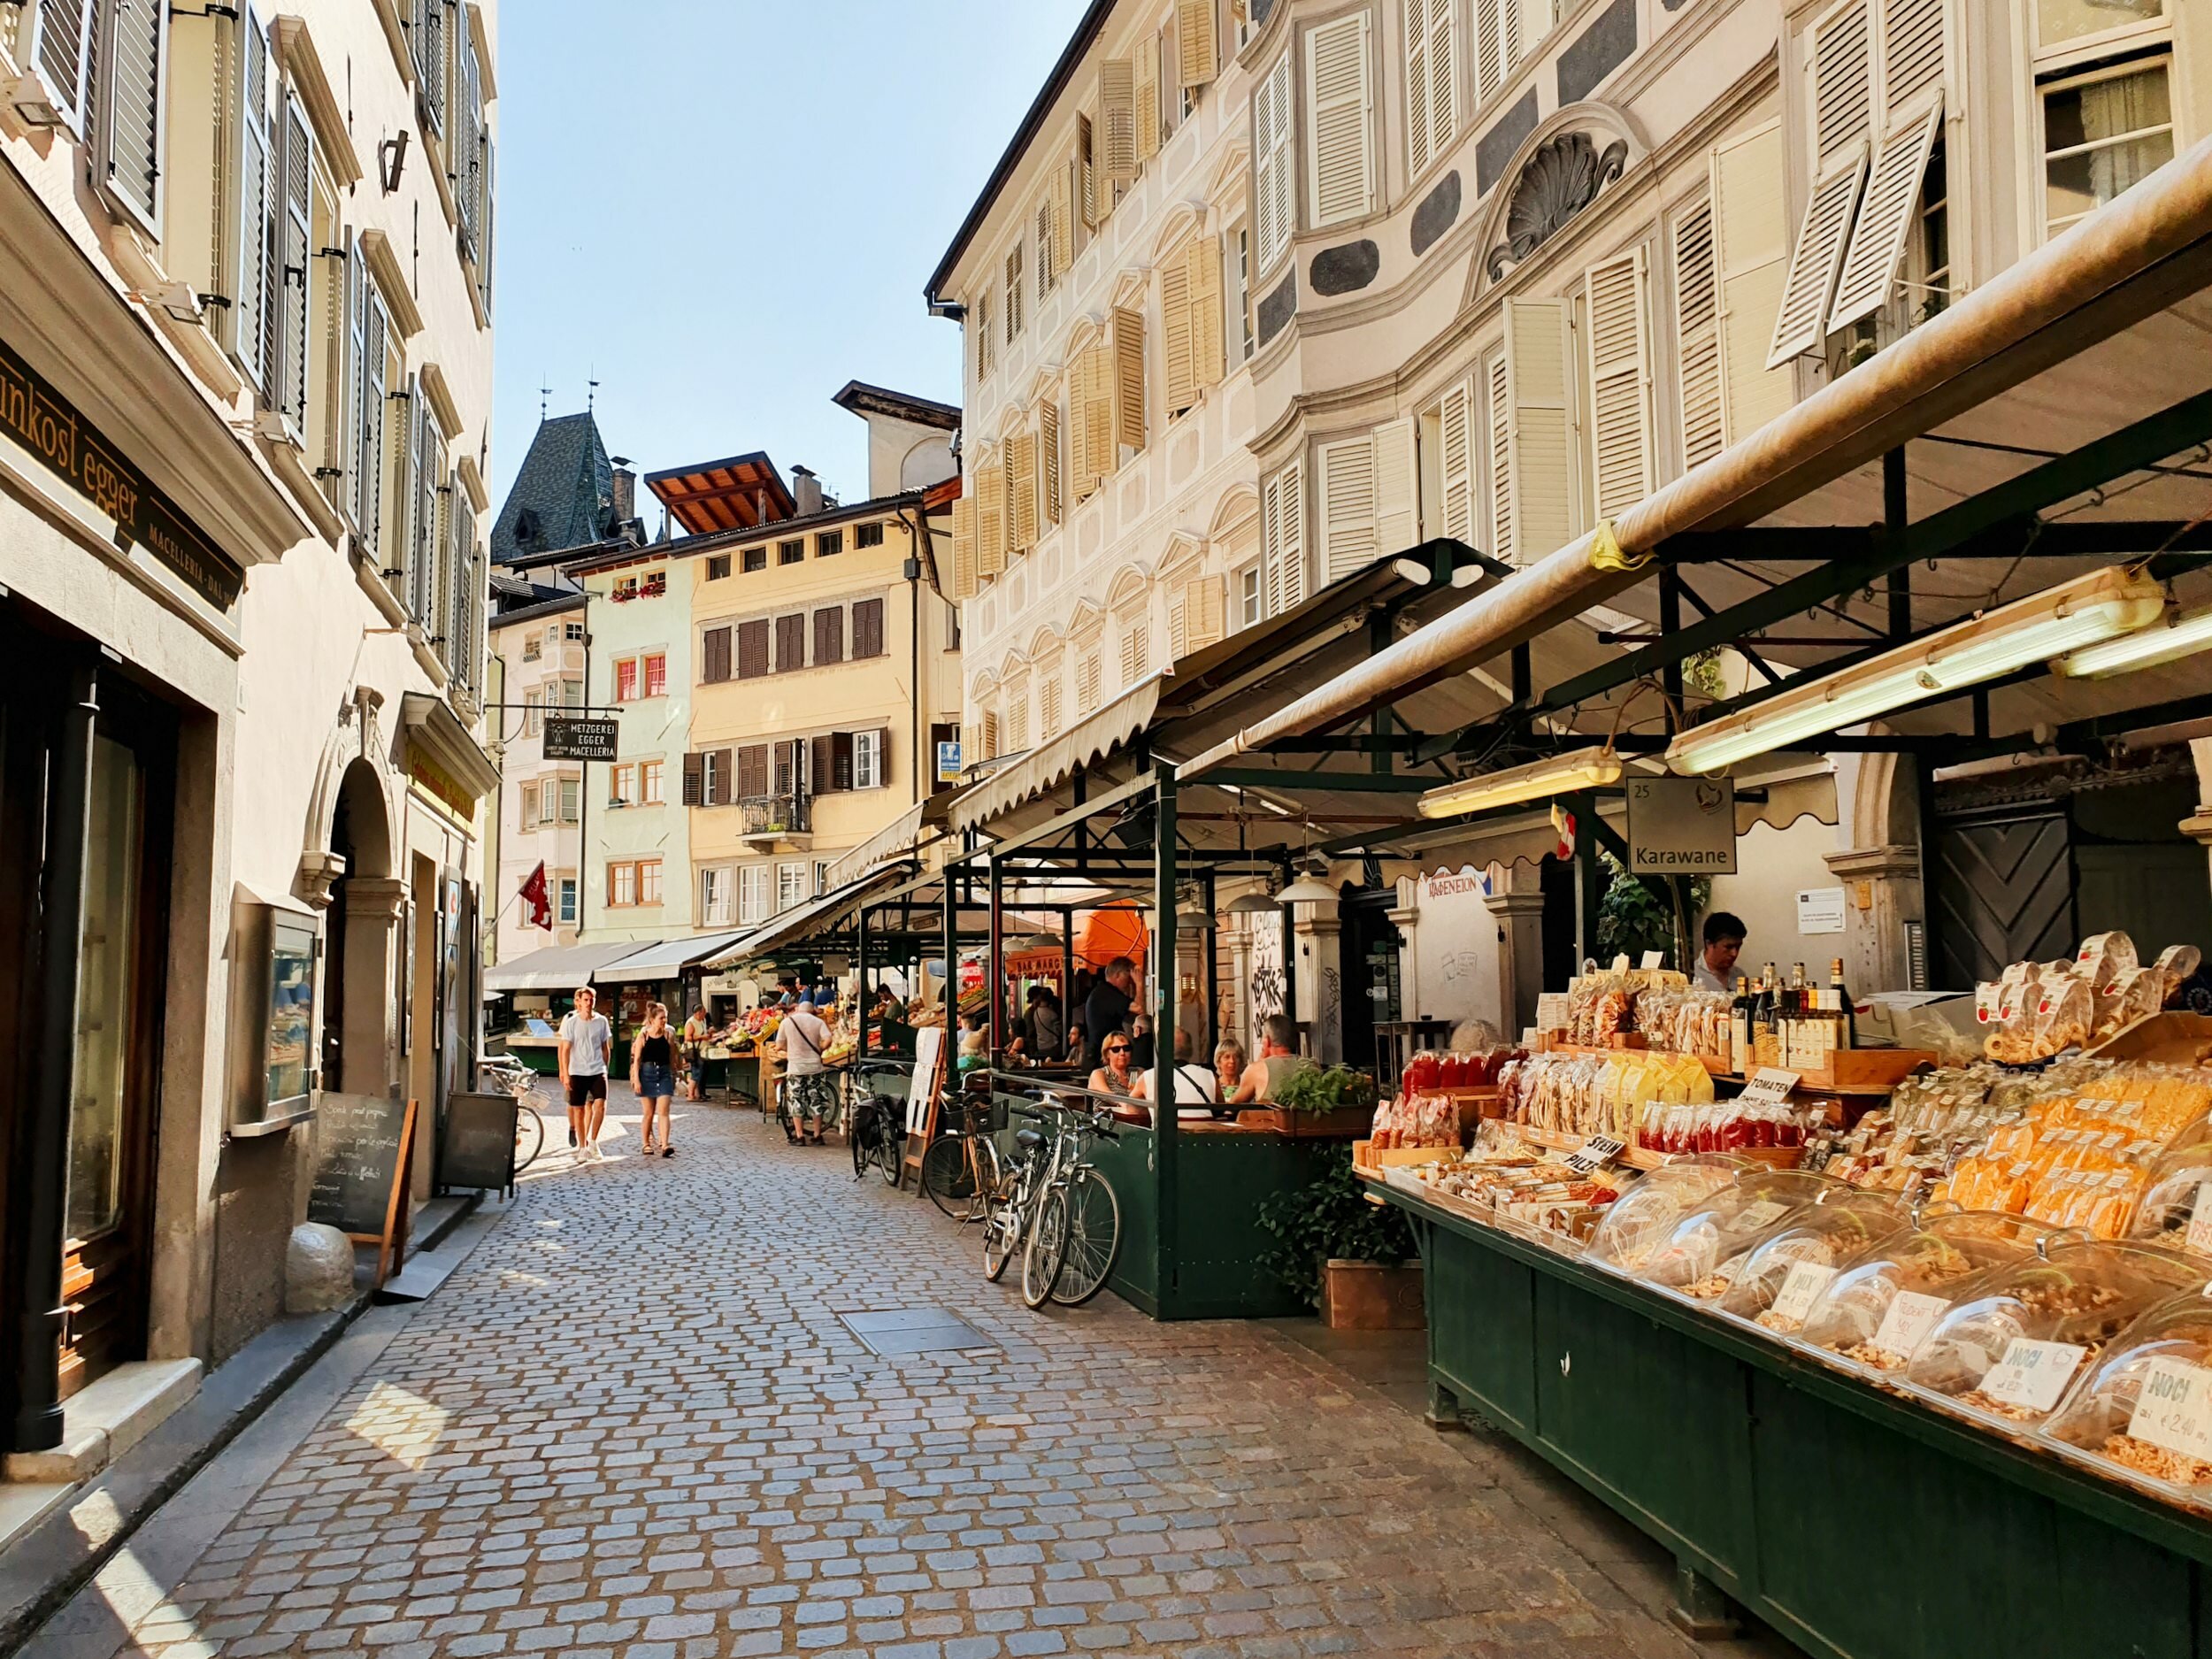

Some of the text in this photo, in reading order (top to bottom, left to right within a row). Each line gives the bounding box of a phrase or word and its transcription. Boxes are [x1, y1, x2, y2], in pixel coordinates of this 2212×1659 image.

[84, 451, 138, 527] egger
[149, 523, 204, 585] MACELLERIA
[571, 723, 615, 734] METZGEREI
[578, 734, 605, 745] EGGER
[569, 746, 615, 757] MACELLERIA
[1634, 785, 1650, 798] 25
[1636, 847, 1727, 864] Karawane
[1750, 1078, 1792, 1094] TOMATEN
[1586, 1136, 1623, 1156] STEIN
[1792, 1272, 1817, 1293] MIX
[2006, 1346, 2044, 1369] NOCI
[2147, 1371, 2192, 1404] NOCI
